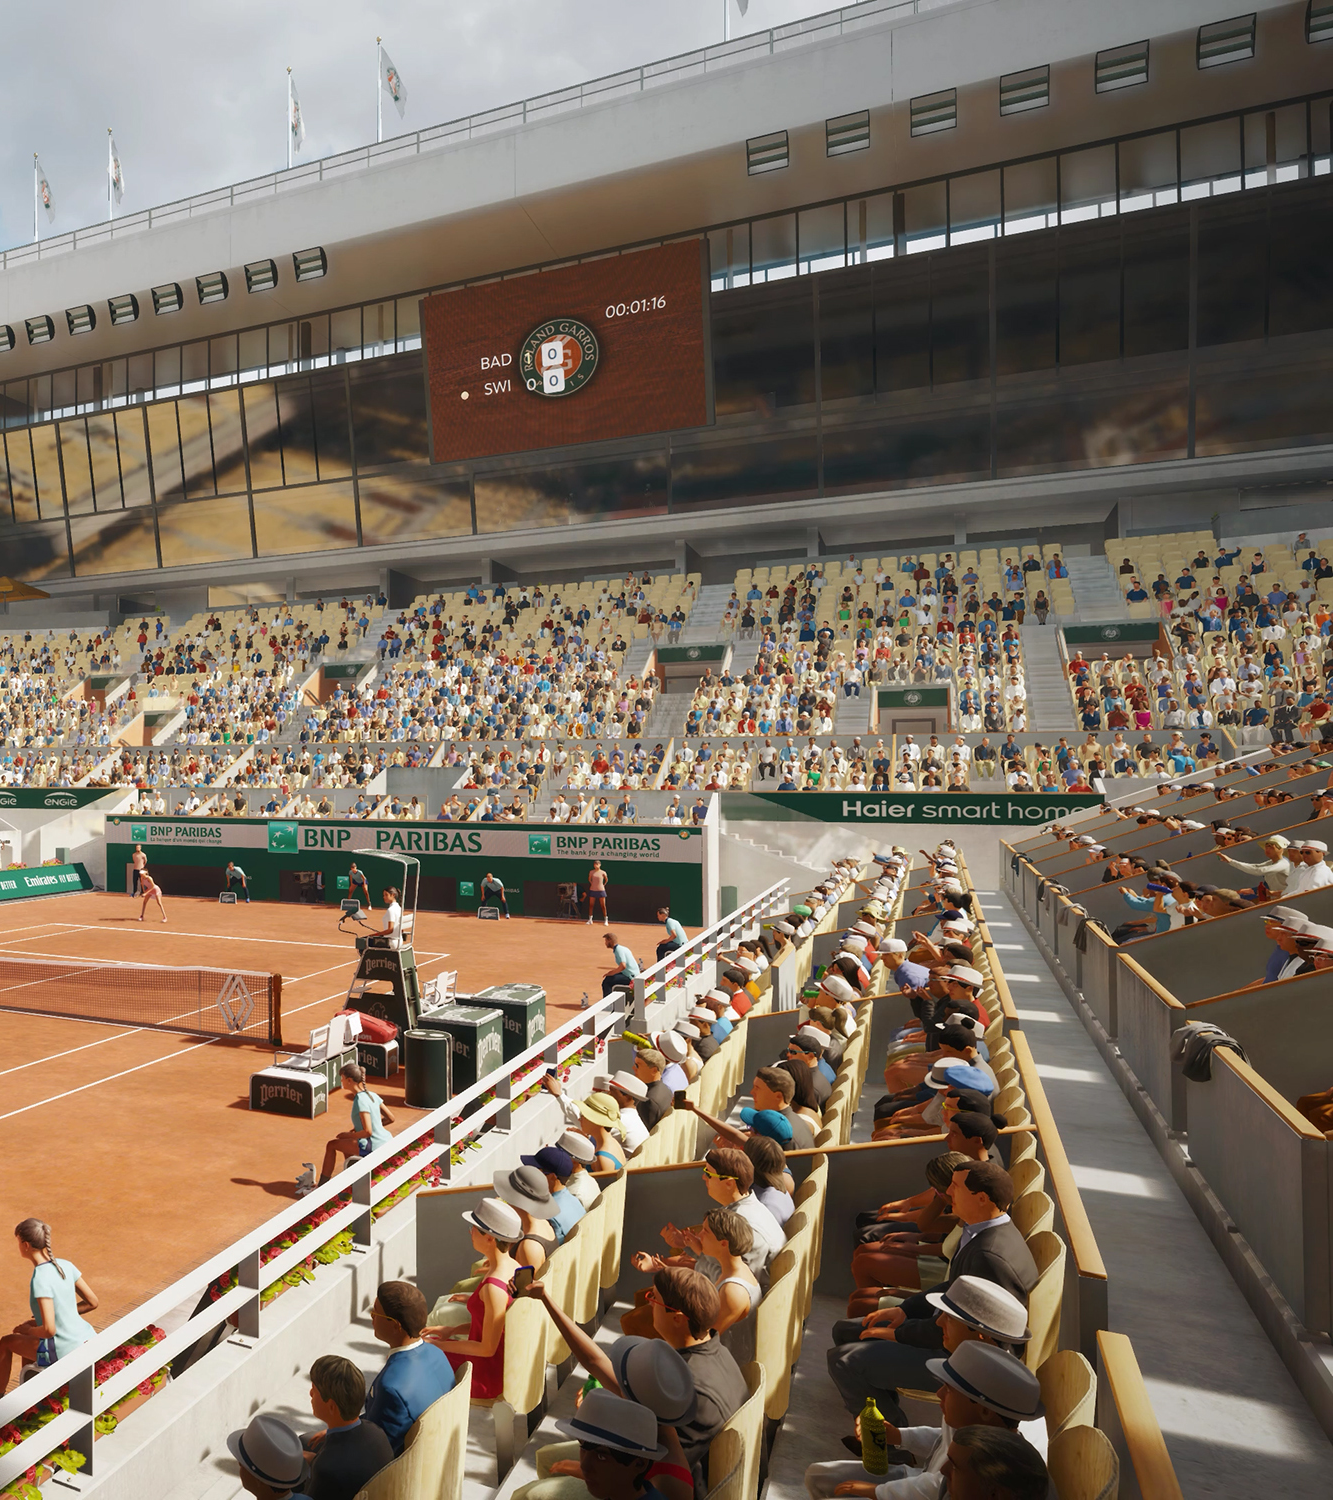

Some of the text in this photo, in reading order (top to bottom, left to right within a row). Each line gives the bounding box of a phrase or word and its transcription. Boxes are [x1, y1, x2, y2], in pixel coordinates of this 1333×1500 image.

[605, 295, 667, 319] 00:01:16
[524, 322, 595, 372] ROLAND GARROS
[480, 353, 513, 370] BAD
[547, 347, 558, 360] 0
[484, 374, 559, 396] SWI 0 0
[842, 800, 915, 818] Haier
[922, 801, 1002, 819] smart
[150, 826, 222, 838] BNP PARIBAS
[304, 828, 483, 853] BNP PARIBAS
[556, 836, 661, 851] BNP PARIBAS
[606, 851, 638, 859] changing
[23, 874, 59, 888] Emirates
[365, 957, 398, 976] perrier
[259, 1083, 304, 1107] perrier
